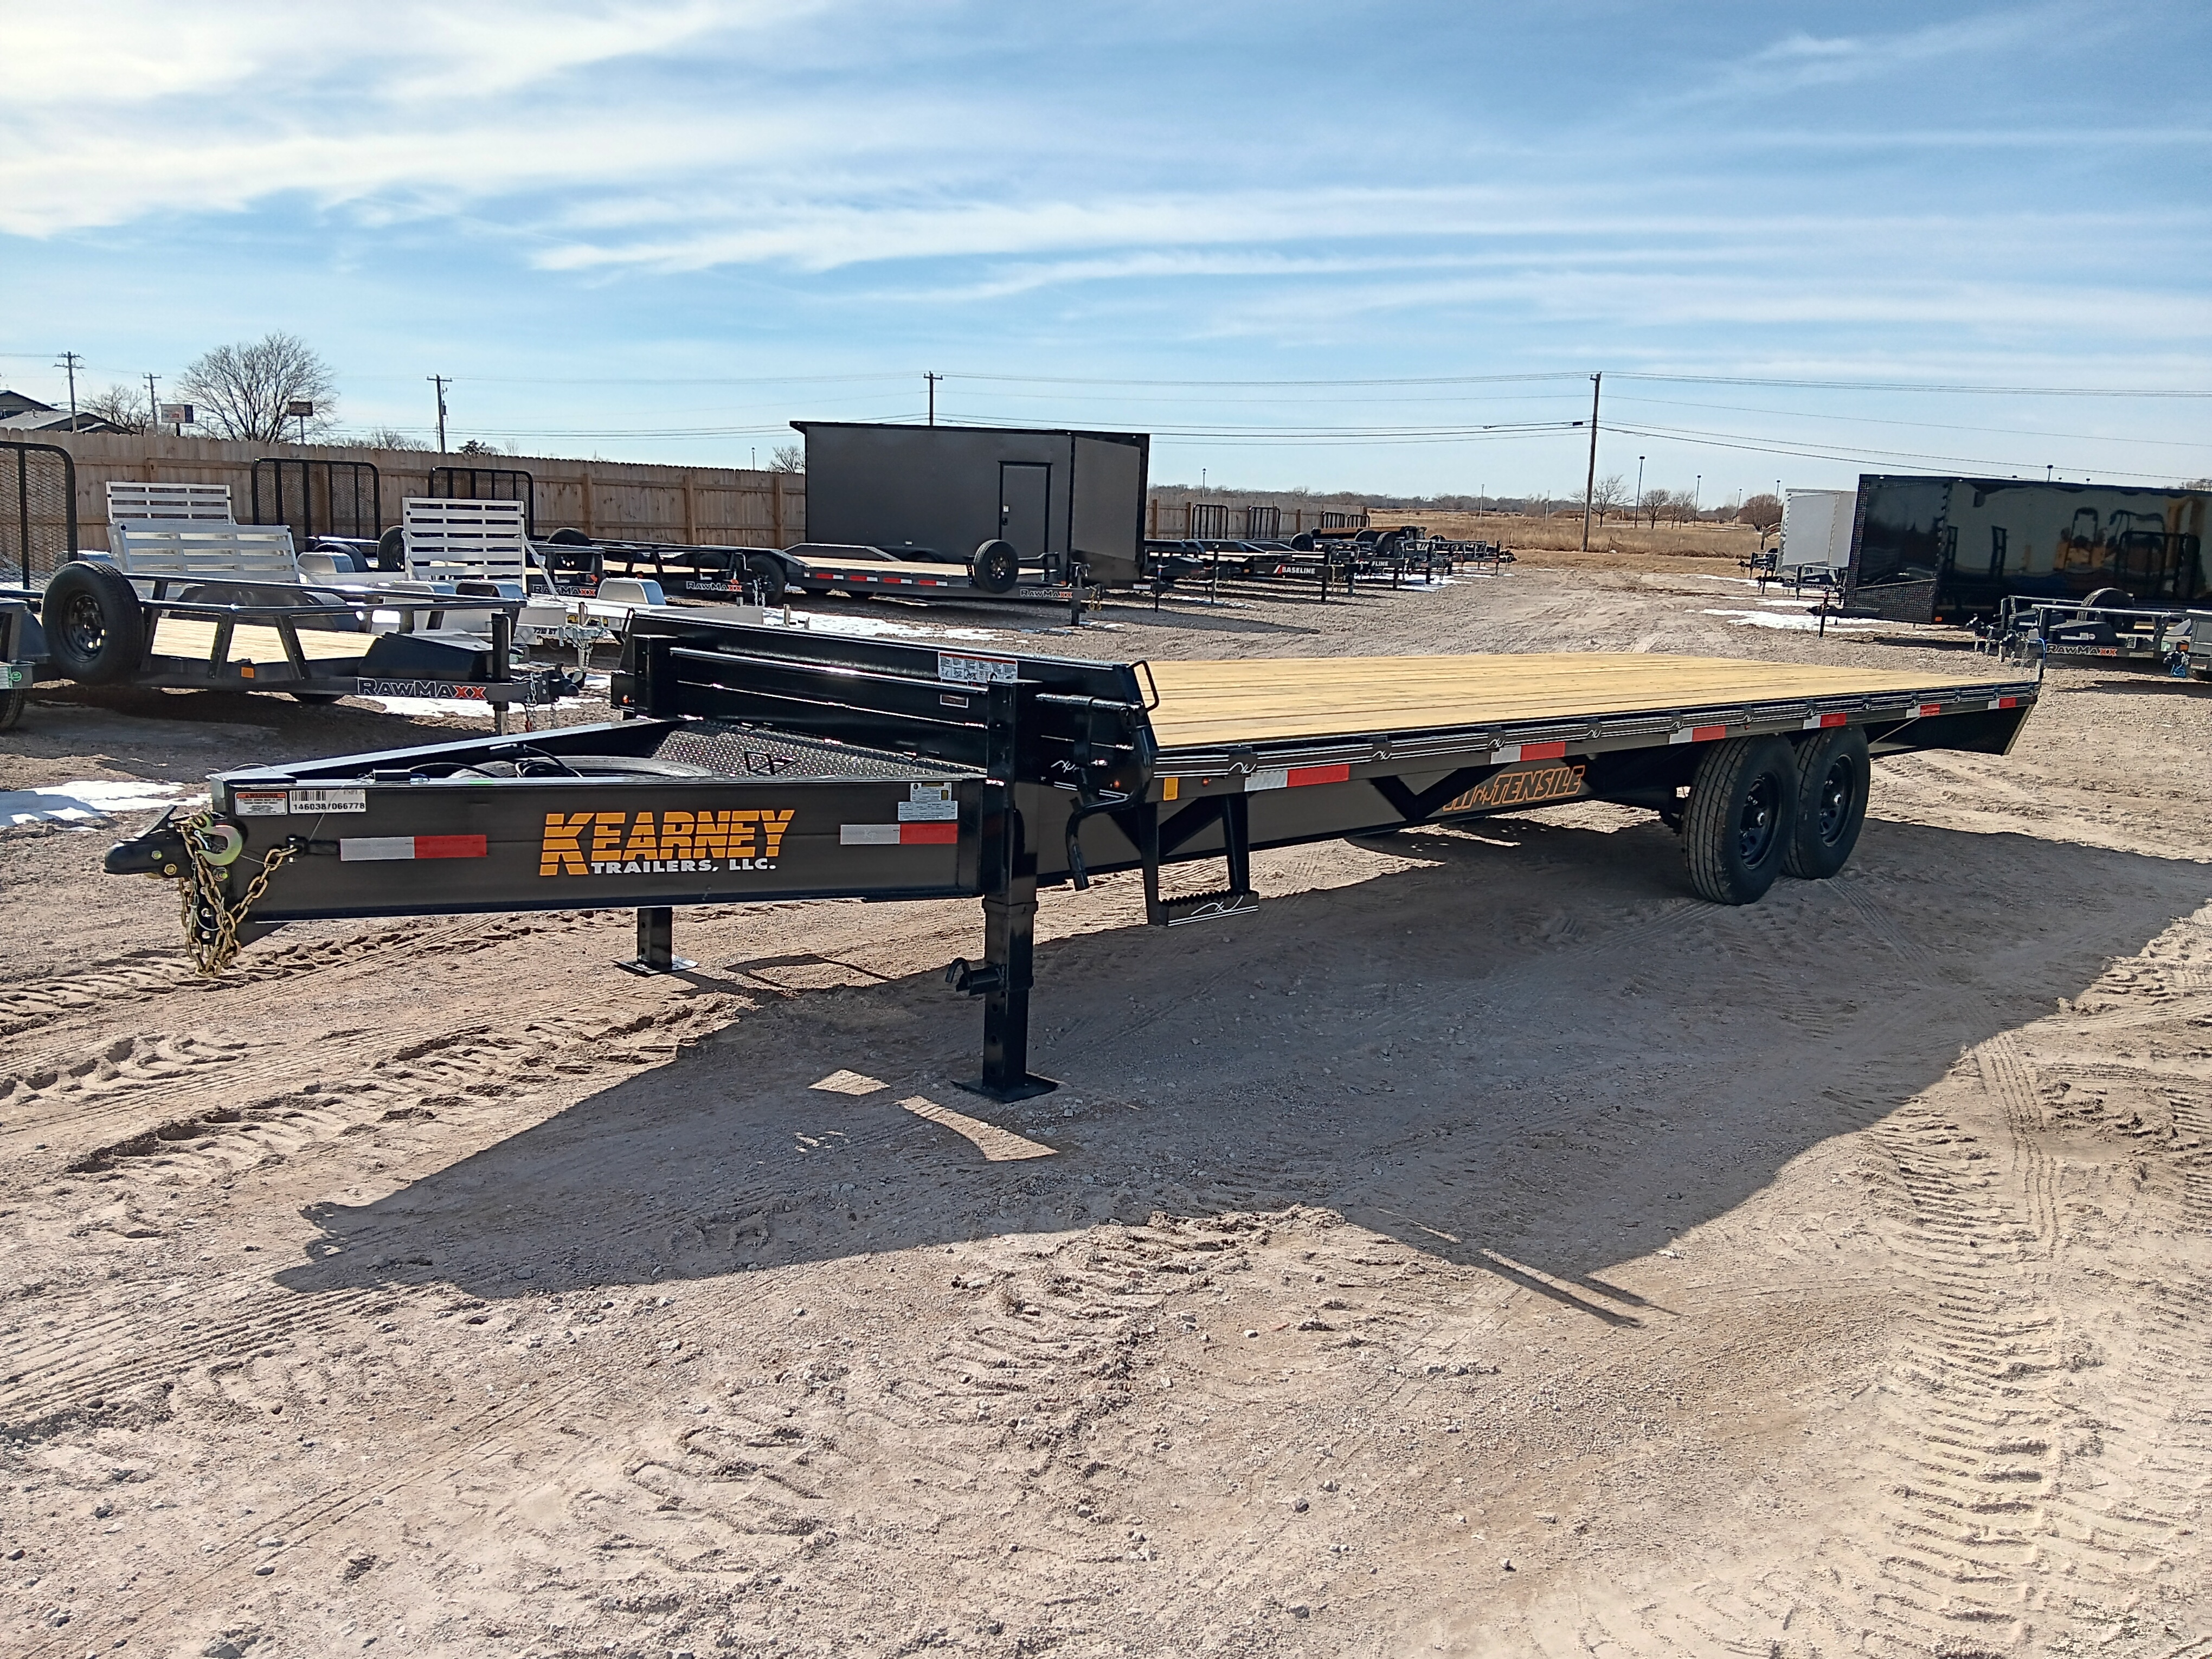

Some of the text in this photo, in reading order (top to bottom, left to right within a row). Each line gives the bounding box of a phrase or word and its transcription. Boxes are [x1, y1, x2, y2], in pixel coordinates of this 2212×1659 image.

[686, 581, 743, 591] RAWMAXX
[1020, 589, 1072, 599] RAWMAXX
[2046, 644, 2118, 656] RAWMAXX
[358, 678, 487, 700] RAWMAXX
[1491, 765, 1586, 806] TENSILE
[293, 802, 365, 811] 146038/066778
[539, 809, 795, 876] KEARNEY
[590, 858, 777, 874] TRAILERS, LLC.
